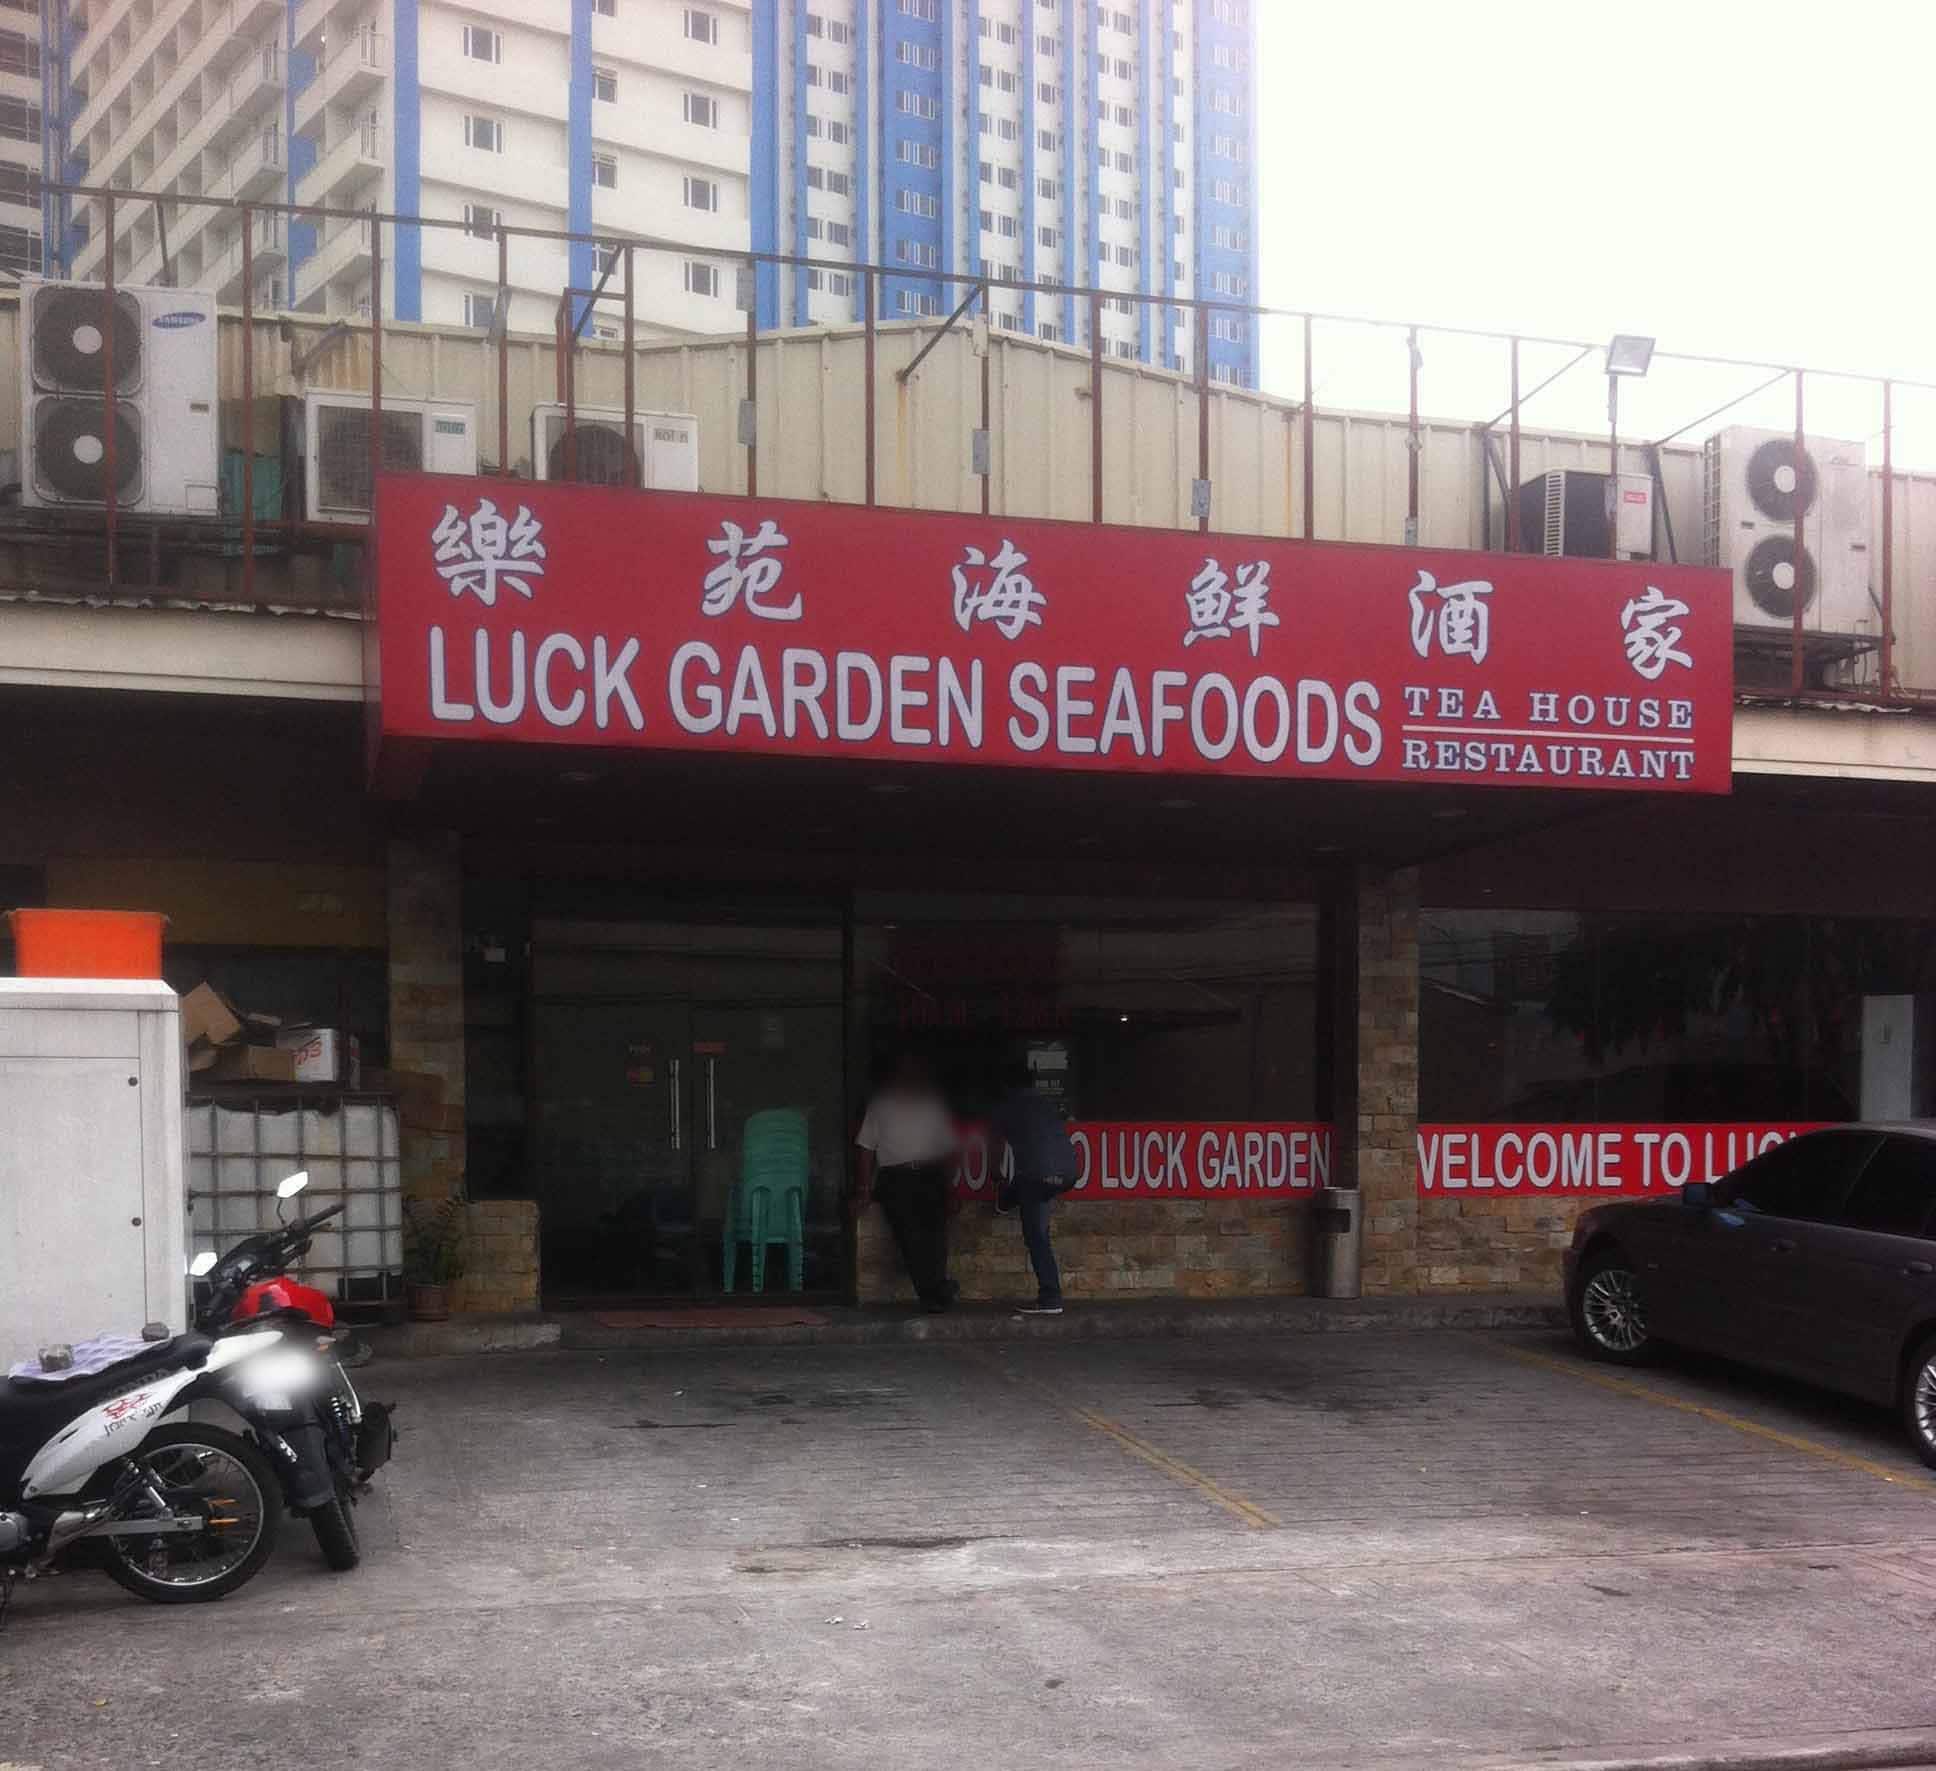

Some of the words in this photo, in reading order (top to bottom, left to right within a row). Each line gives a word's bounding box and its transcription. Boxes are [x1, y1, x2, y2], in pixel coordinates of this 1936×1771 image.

[431, 498, 1693, 680] 樂苑海鮮酒家
[430, 626, 645, 731] LUCK
[669, 640, 984, 748] GARDEN
[1008, 661, 1382, 766] SEAFOODS
[1404, 686, 1501, 720] TEA
[1529, 692, 1692, 729] HOUSE
[1402, 739, 1695, 779] RESTAURANT
[1101, 1131, 1188, 1189] LUCK
[1197, 1130, 1331, 1188] GARDEN
[1633, 1132, 1693, 1188] TO
